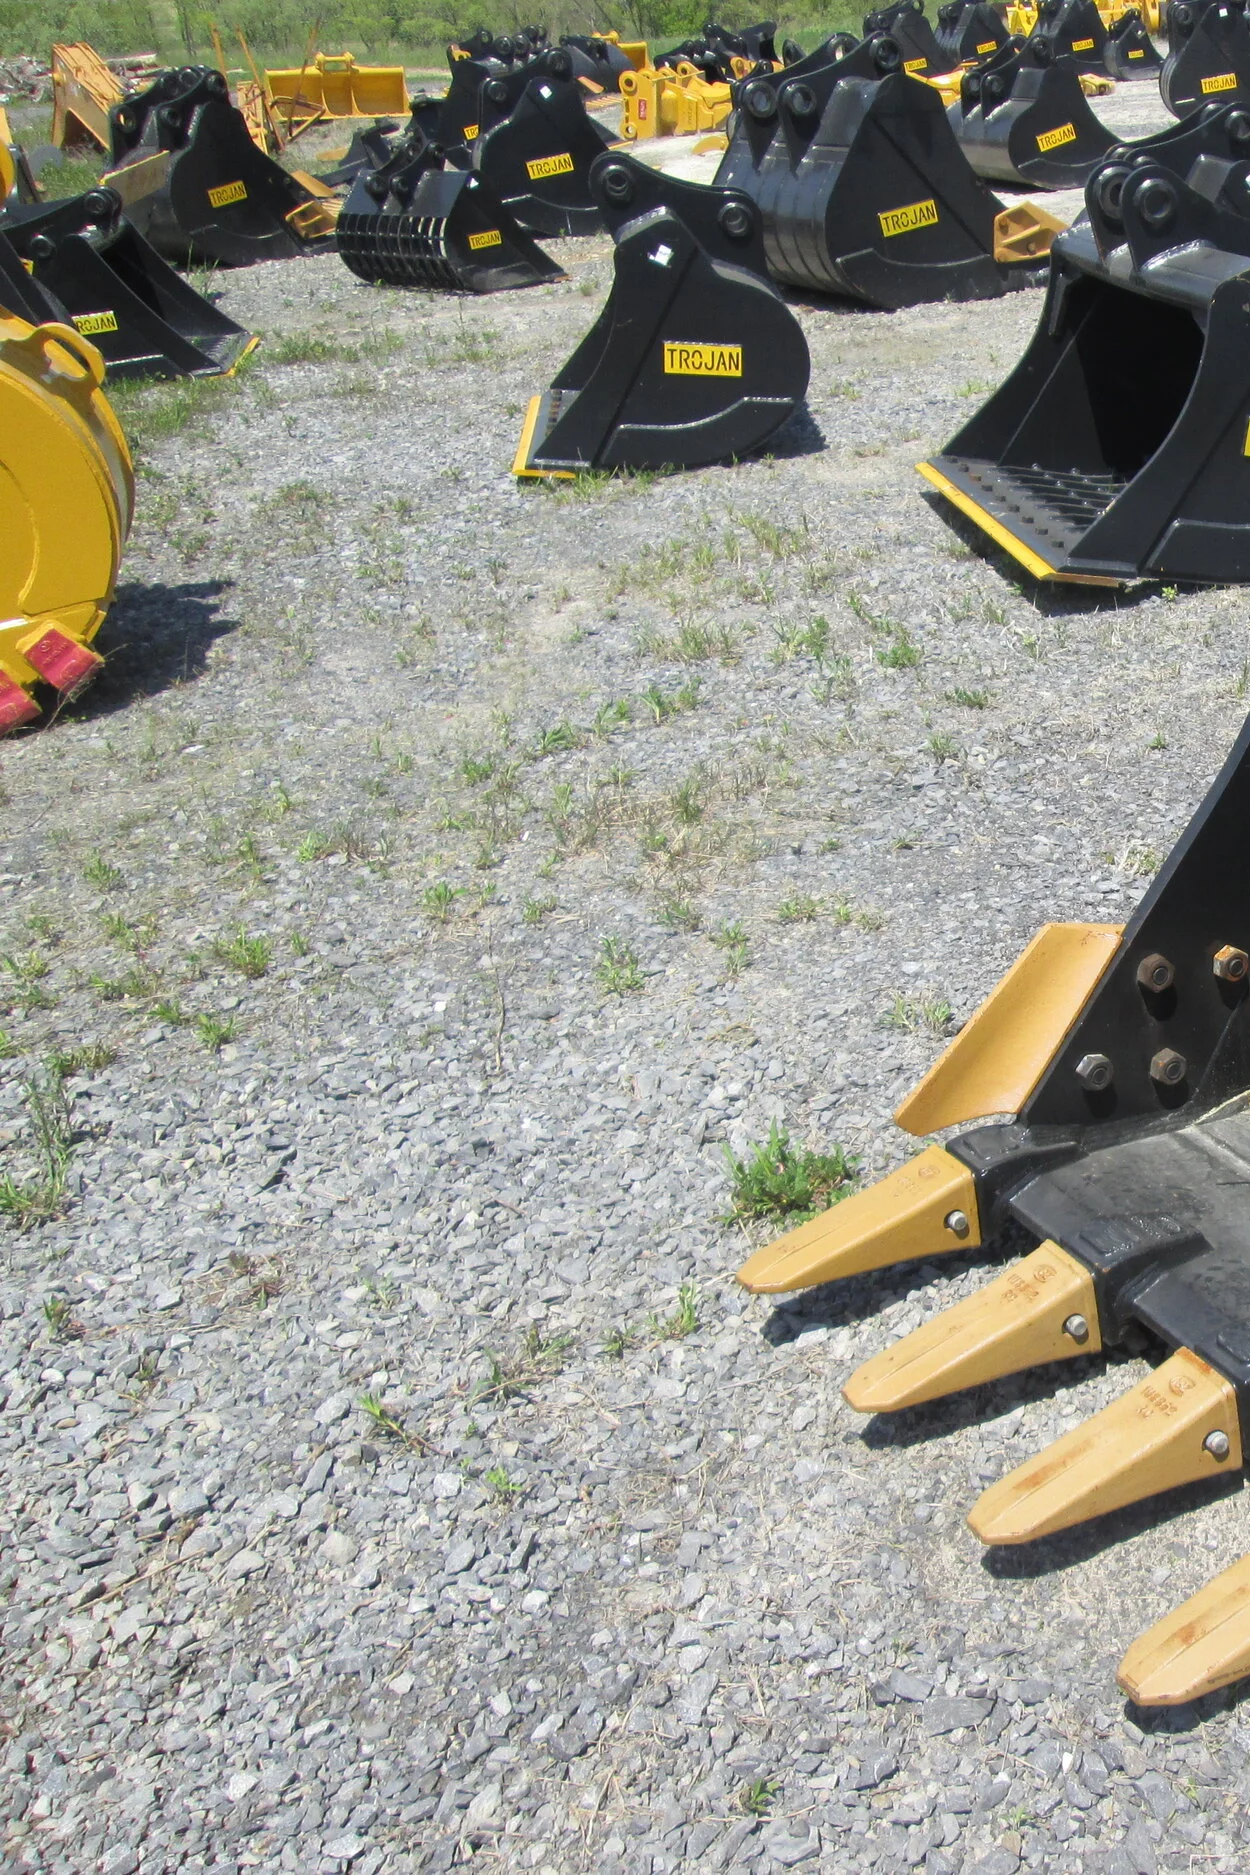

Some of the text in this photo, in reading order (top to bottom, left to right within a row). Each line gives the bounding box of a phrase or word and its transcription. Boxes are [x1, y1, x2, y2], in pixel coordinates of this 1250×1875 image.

[1202, 76, 1236, 92] TROJAN
[1039, 126, 1074, 149] TROJAN
[528, 157, 572, 178] TROJAN
[210, 183, 245, 205] TROJAN
[882, 203, 936, 232] TROJAN
[470, 231, 500, 248] TROJAN
[667, 348, 740, 371] TROJAN
